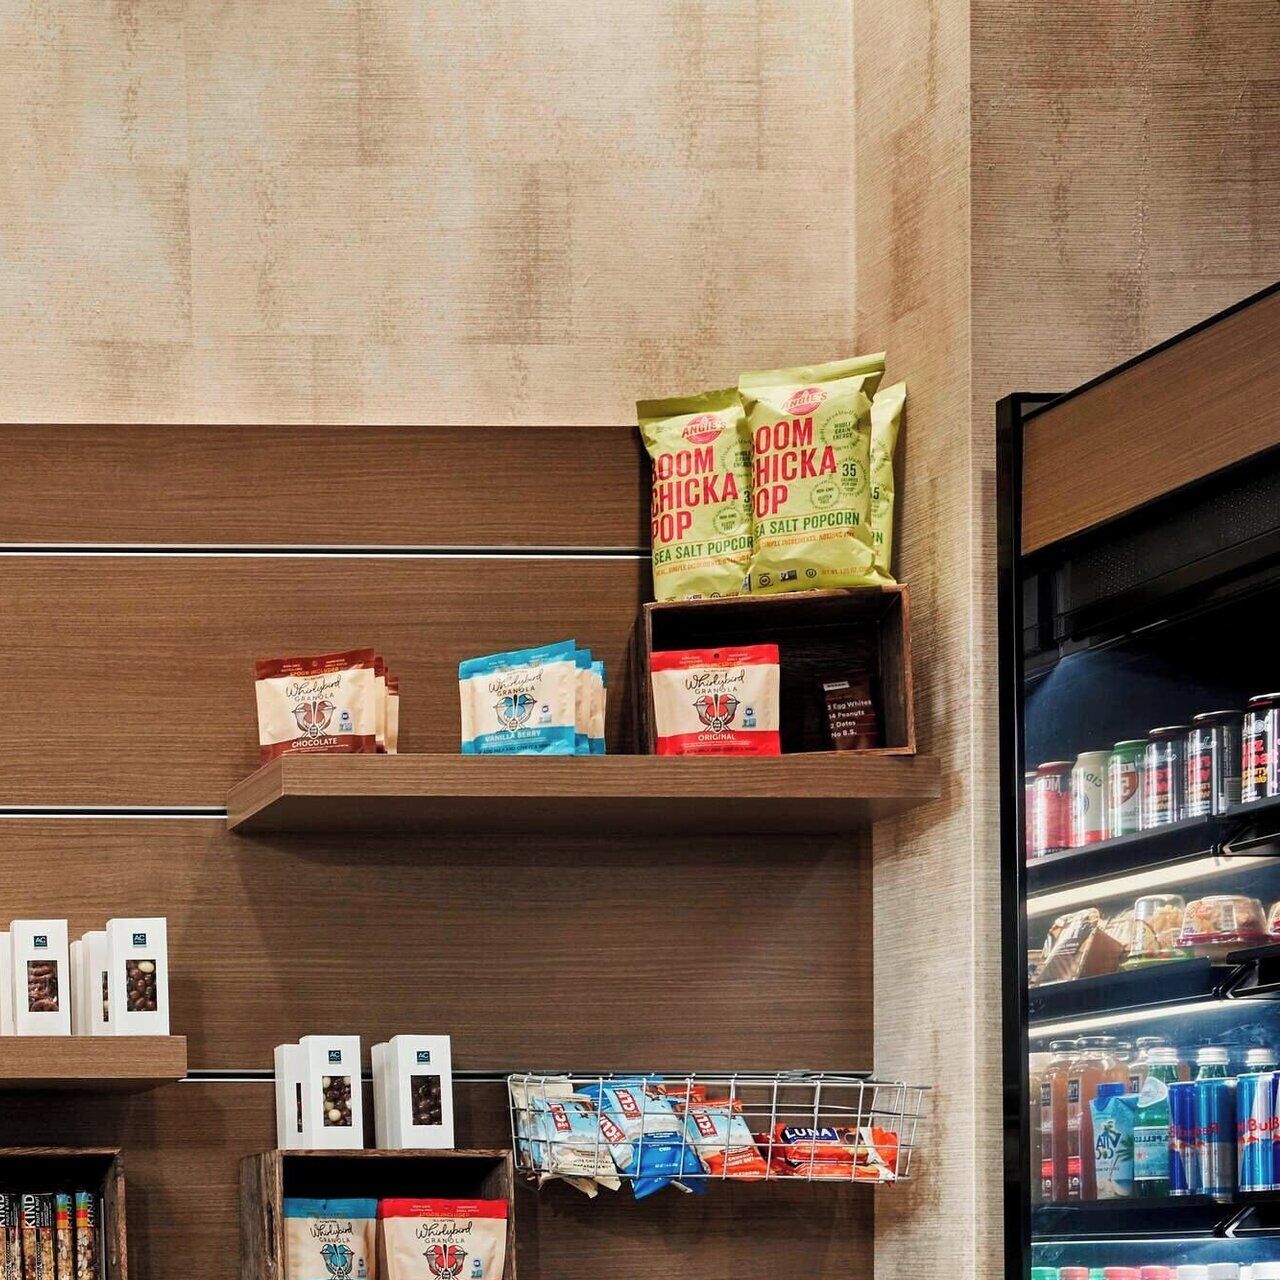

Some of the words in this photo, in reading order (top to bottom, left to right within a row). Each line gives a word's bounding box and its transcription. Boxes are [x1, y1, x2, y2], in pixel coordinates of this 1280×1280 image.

[681, 421, 727, 439] ANGIE'S
[842, 463, 857, 477] 35
[770, 519, 797, 534] SALT
[803, 512, 860, 530] POPCORN
[694, 687, 738, 695] GRANOLA
[837, 710, 865, 719] Peanuts
[485, 732, 515, 742] VANILLA
[517, 730, 541, 738] BERRY
[698, 733, 735, 741] ORIGINAL
[292, 738, 338, 748] CHOCOLATE
[784, 1126, 832, 1140] LUNA
[24, 1194, 35, 1227] KIND
